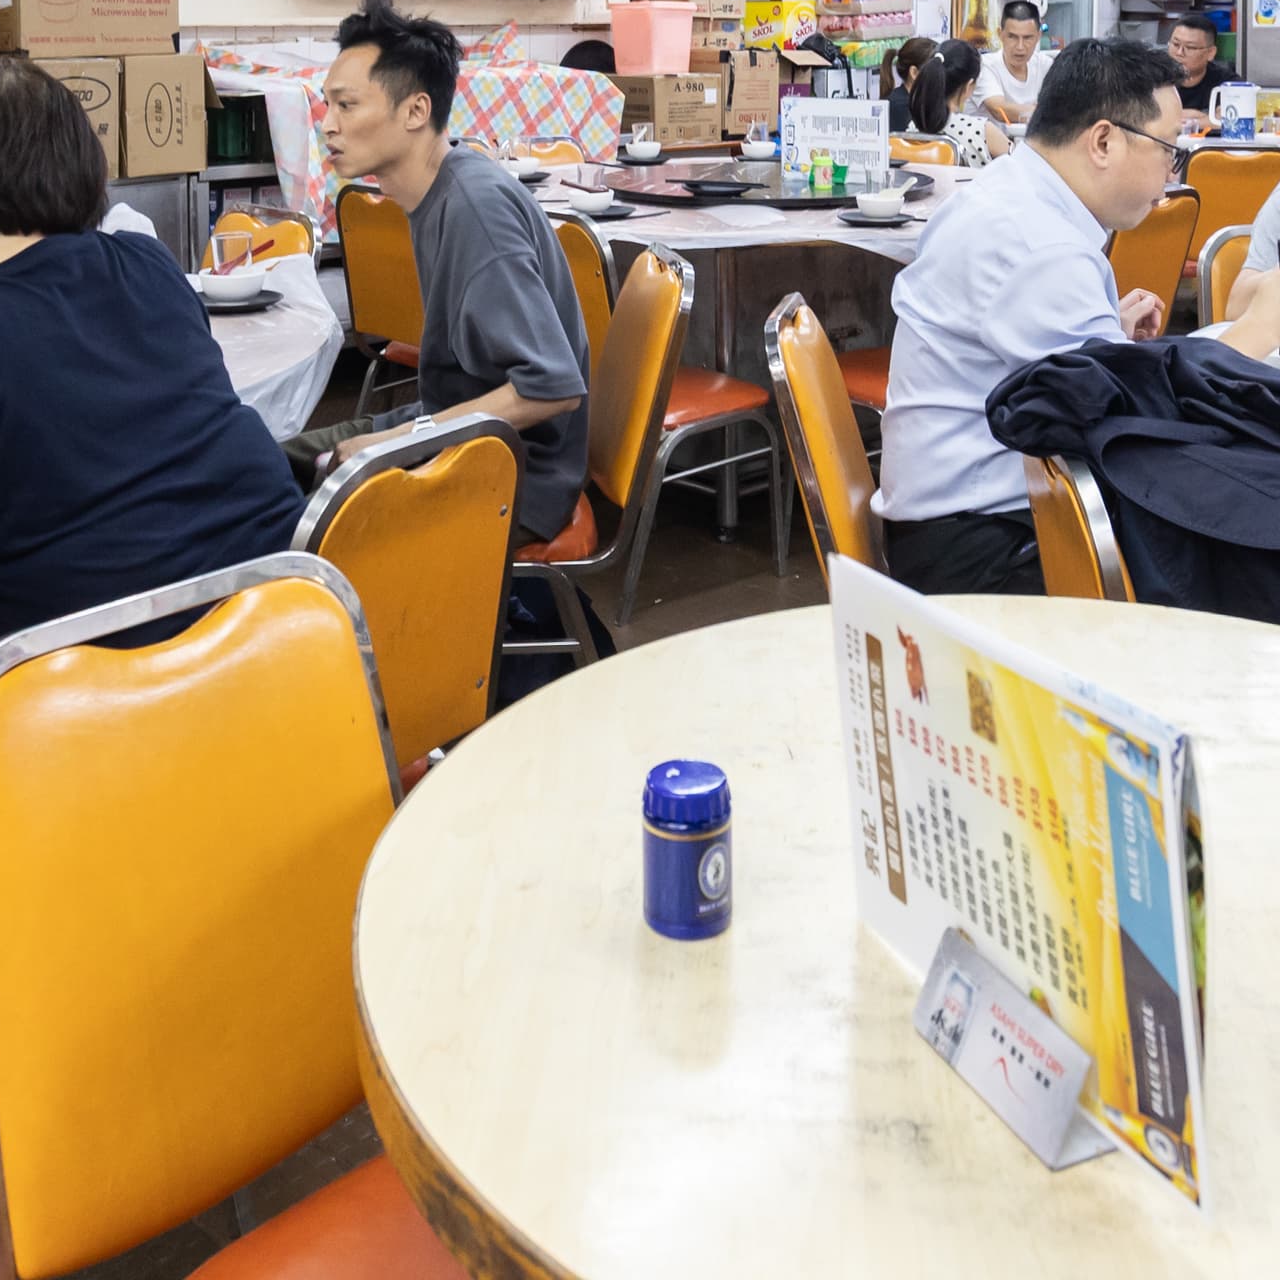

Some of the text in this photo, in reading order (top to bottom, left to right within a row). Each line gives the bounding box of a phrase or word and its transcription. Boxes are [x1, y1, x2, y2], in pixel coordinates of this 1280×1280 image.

[91, 7, 147, 18] Microwavable
[752, 25, 775, 39] SKOL
[795, 24, 816, 39] SKOL
[674, 82, 704, 93] A-980
[1120, 786, 1142, 905] BLUE GIRL
[1141, 998, 1165, 1120] BLUE GIRL
